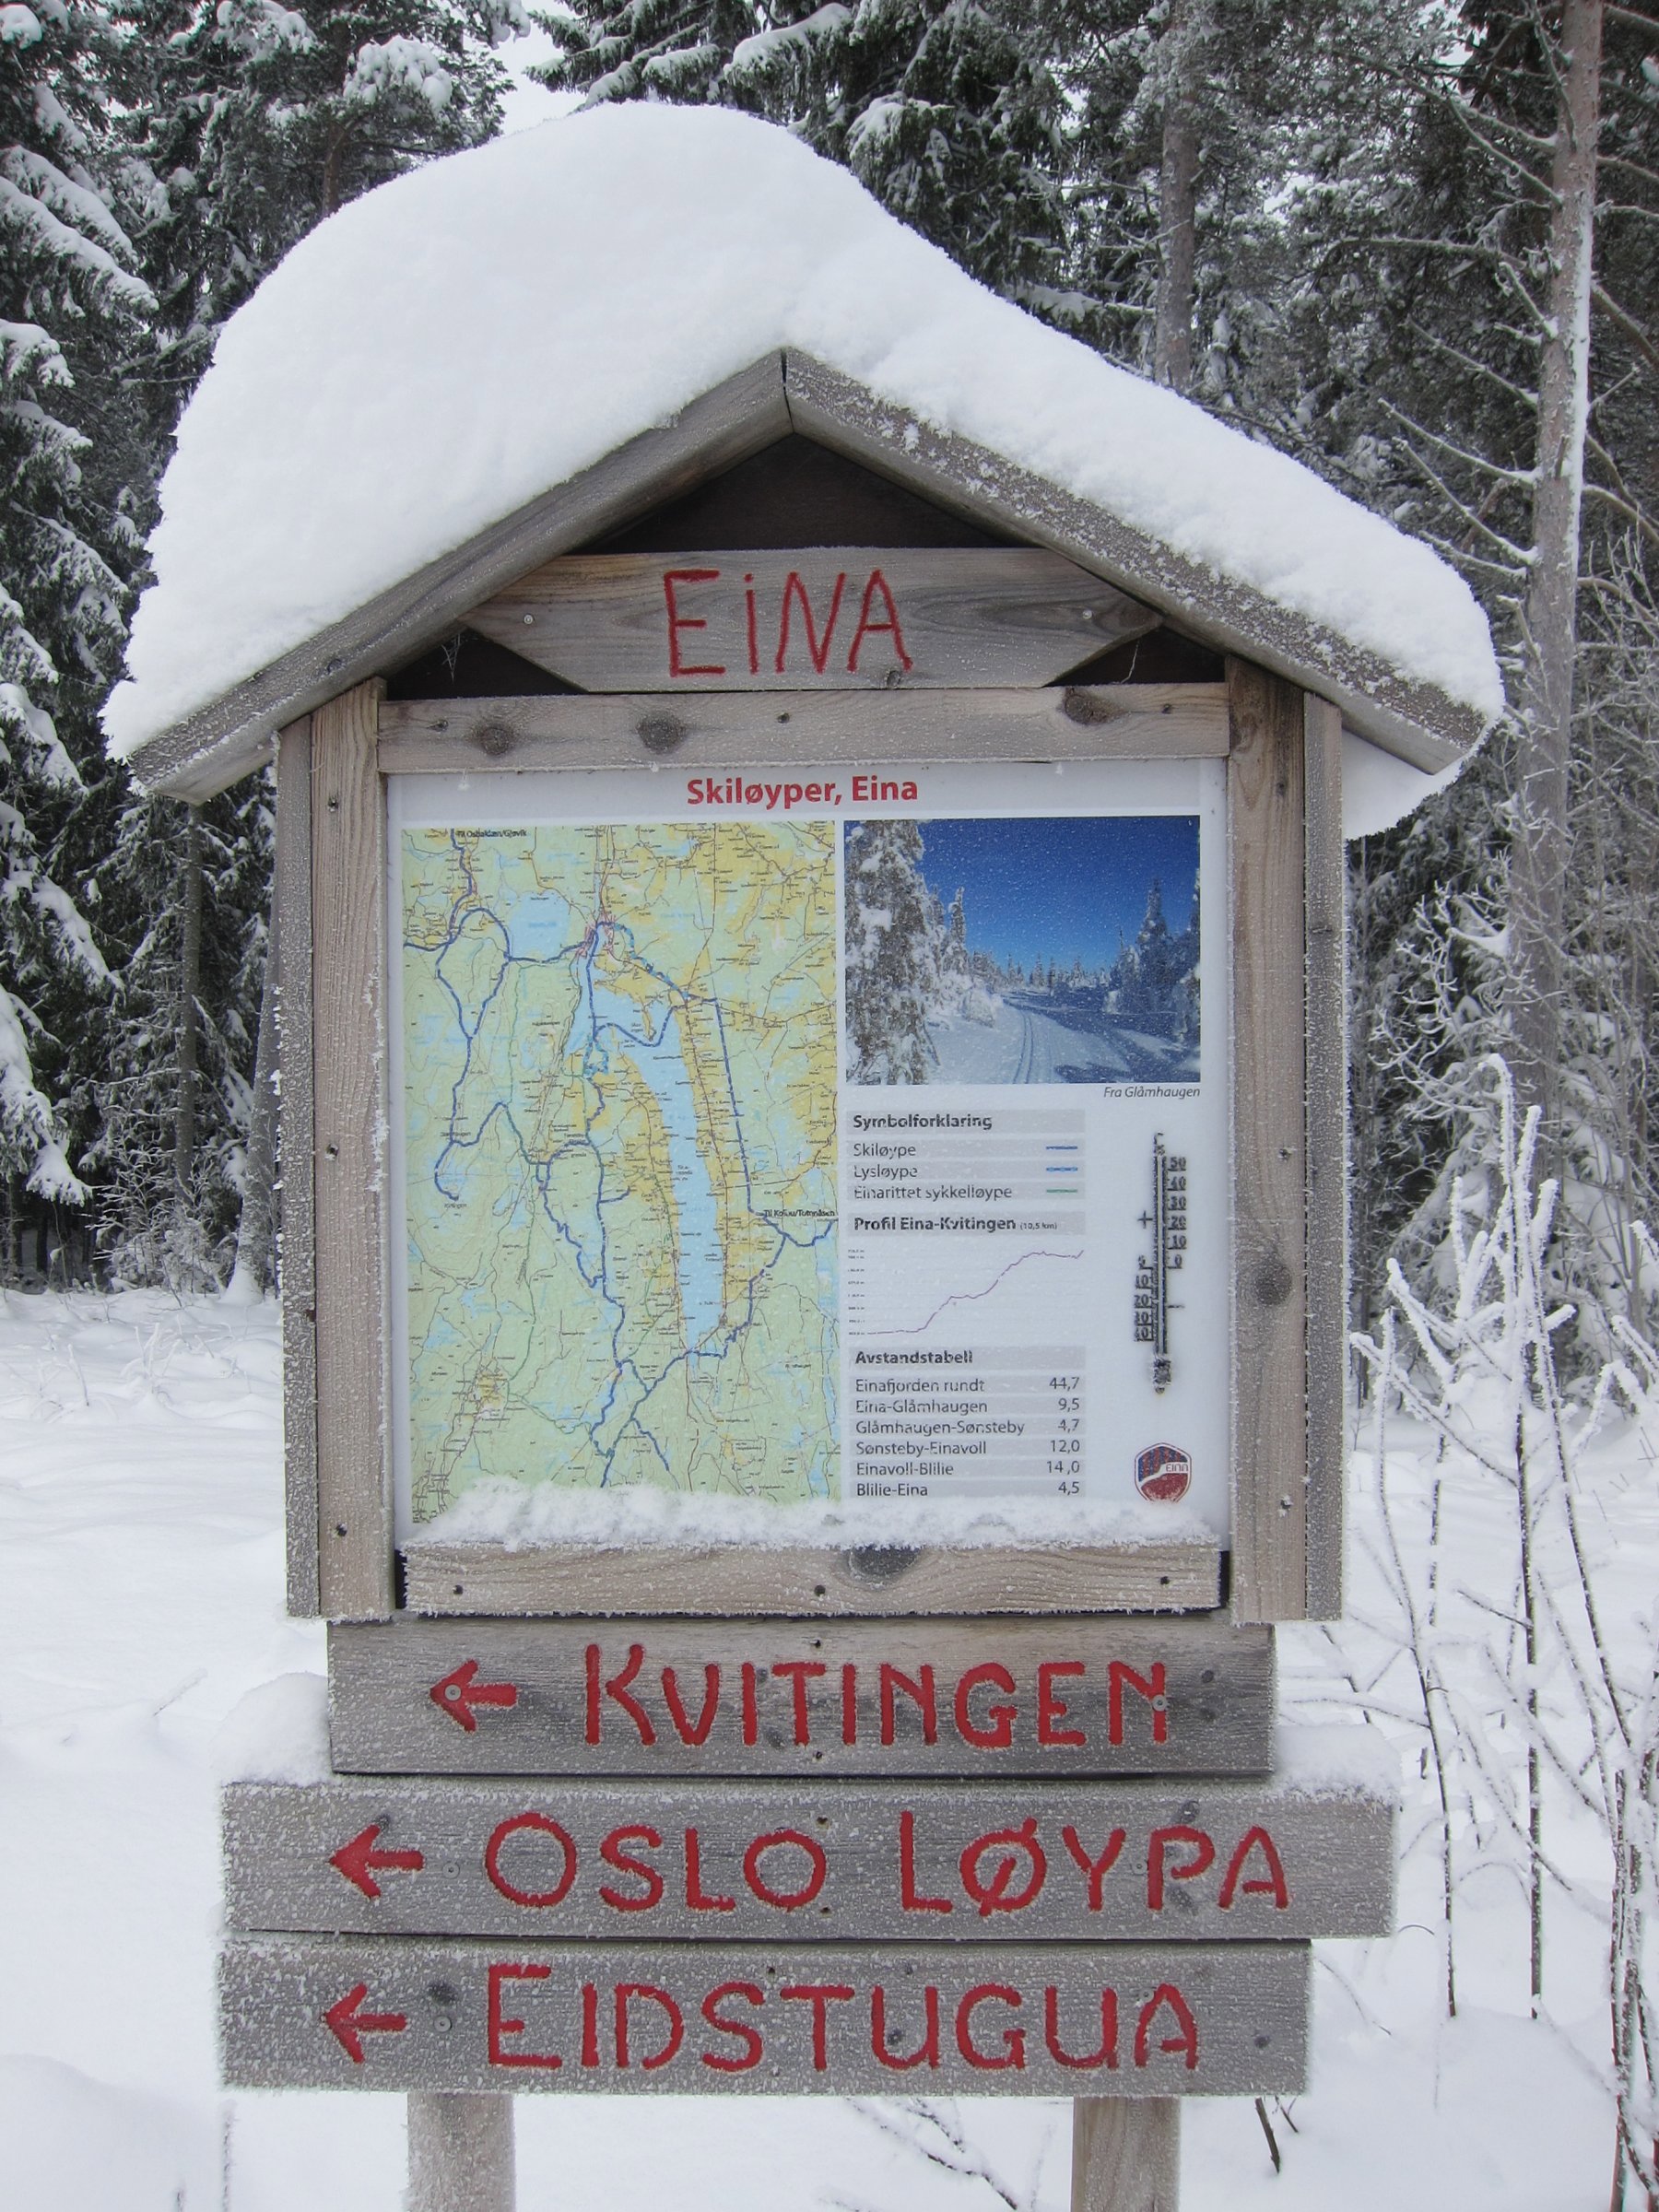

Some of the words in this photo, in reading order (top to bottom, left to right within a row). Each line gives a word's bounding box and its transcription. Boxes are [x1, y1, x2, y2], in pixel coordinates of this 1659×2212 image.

[688, 777, 842, 810] Skiløyper,
[852, 774, 919, 802] Eina
[1104, 1086, 1123, 1098] Fra
[1124, 1086, 1201, 1100] Glåmhaugen
[853, 1113, 993, 1131] Symbolforklaring
[853, 1142, 917, 1159] Skiløype
[853, 1163, 918, 1181] Lysløype
[853, 1185, 922, 1199] Einarittet
[924, 1184, 1013, 1202] sykkelløype
[853, 1216, 897, 1230] Profil
[900, 1216, 1017, 1233] Eina-Kvitingen
[854, 1350, 973, 1364] Avstandstabell
[855, 1378, 940, 1394] Einafjorden
[944, 1379, 985, 1393] rundt
[1049, 1376, 1080, 1392] 44,7
[855, 1399, 988, 1416] Eina-Glåmhaugen
[1058, 1397, 1080, 1412] 9,5
[855, 1419, 1026, 1437] Glåmhaugen-Sønsteby
[1058, 1418, 1080, 1433] 4,7
[855, 1440, 987, 1457] Sønsteby-Einavoll
[1050, 1439, 1080, 1453] 12,0
[856, 1461, 954, 1476] Einavoll-Blilie
[856, 1482, 928, 1497] Blilie-Eina
[1057, 1481, 1080, 1496] 4,5
[584, 1642, 1169, 1750] KVITINGEN
[484, 1811, 829, 1912] OSLO
[898, 1809, 1289, 1918] LØYPA
[486, 1962, 1199, 2074] EIDSTUGUA
